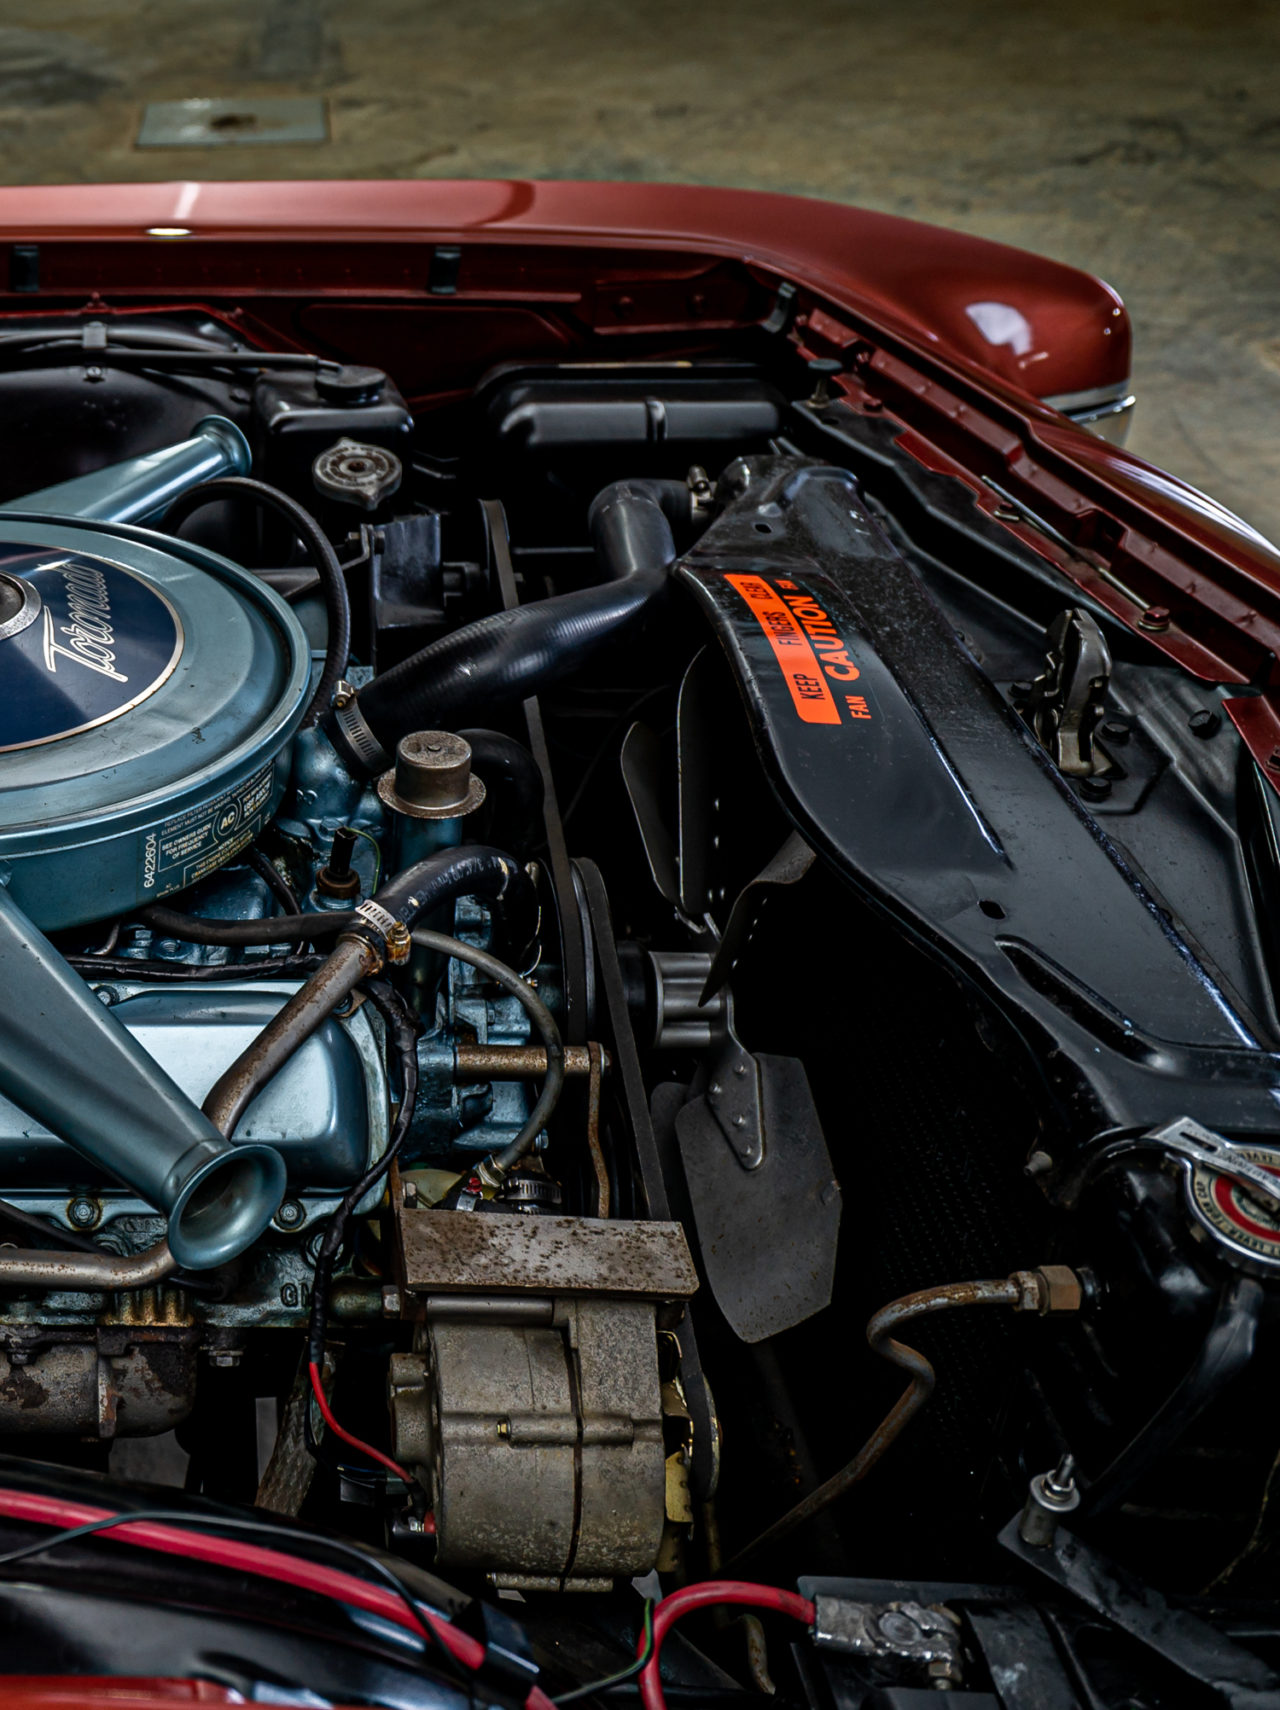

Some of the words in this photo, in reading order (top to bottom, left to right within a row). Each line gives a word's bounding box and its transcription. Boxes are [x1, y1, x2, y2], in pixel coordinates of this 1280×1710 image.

[39, 562, 129, 684] Toronado
[762, 611, 803, 646] FINGERS
[783, 595, 860, 681] CAUTION
[793, 673, 826, 700] KEEP
[844, 695, 872, 719] FAN
[220, 811, 236, 830] AC
[143, 832, 158, 888] 6422604
[165, 846, 179, 857] FOR
[171, 850, 181, 860] OF
